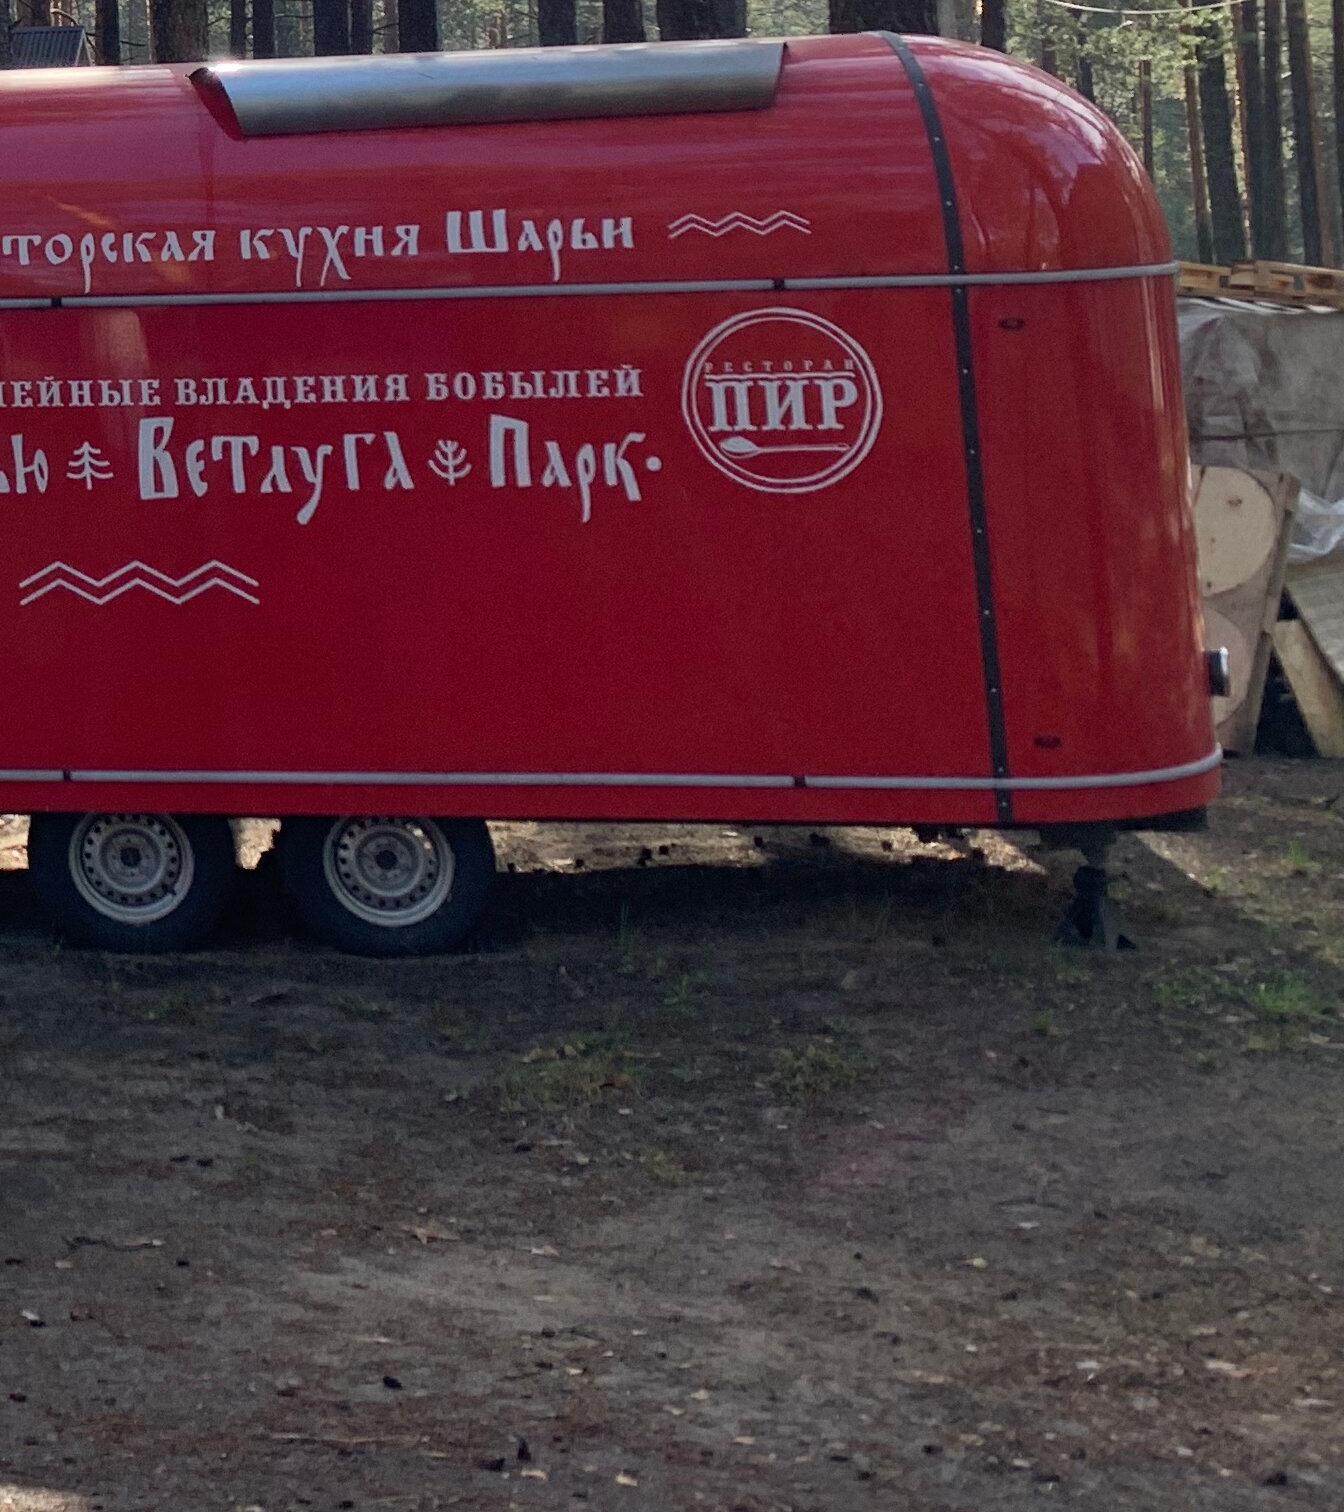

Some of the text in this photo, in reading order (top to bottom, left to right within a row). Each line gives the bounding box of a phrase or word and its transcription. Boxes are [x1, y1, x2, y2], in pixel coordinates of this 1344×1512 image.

[240, 224, 420, 288] кухня
[446, 209, 634, 282] Шарьи
[174, 372, 410, 409] ВЛАДЕНИЯ
[424, 364, 644, 401] БОБЫЛЕЙ
[704, 359, 855, 373] РЕСТОРАН
[704, 379, 858, 432] ПИР
[138, 416, 415, 525] Ветлуга
[489, 413, 646, 523] Парк
